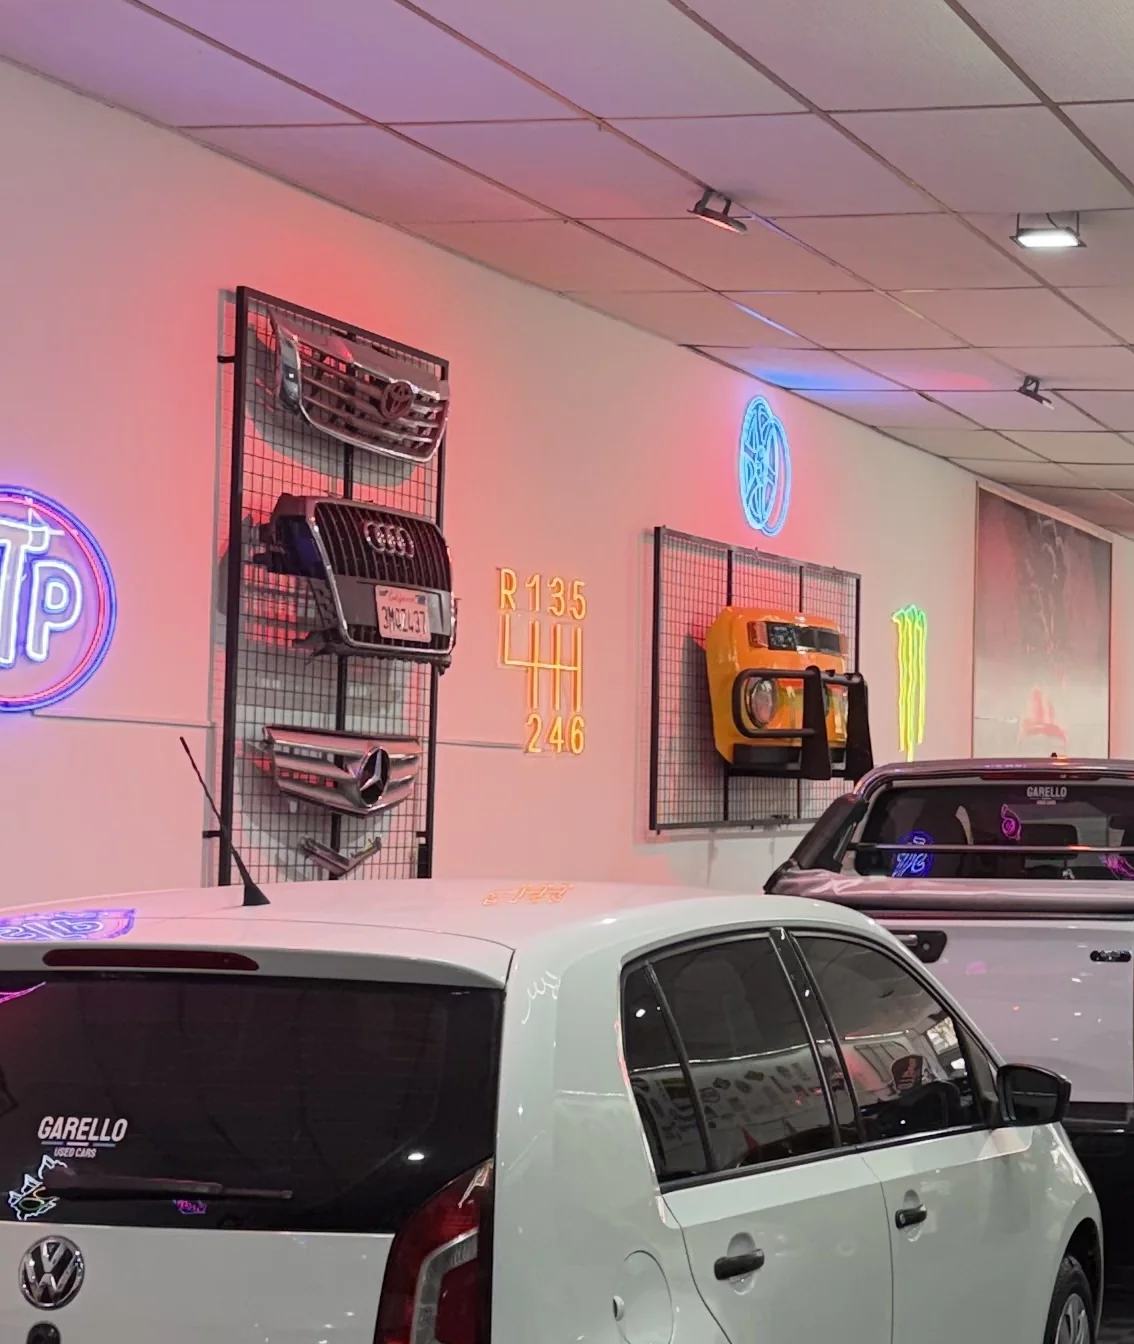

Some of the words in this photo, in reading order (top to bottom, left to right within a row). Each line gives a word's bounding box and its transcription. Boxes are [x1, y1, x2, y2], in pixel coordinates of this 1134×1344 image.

[1026, 786, 1068, 798] GARELLO
[37, 1115, 129, 1143] GARELLO
[53, 1146, 75, 1158] USED
[75, 1147, 98, 1159] CARS
